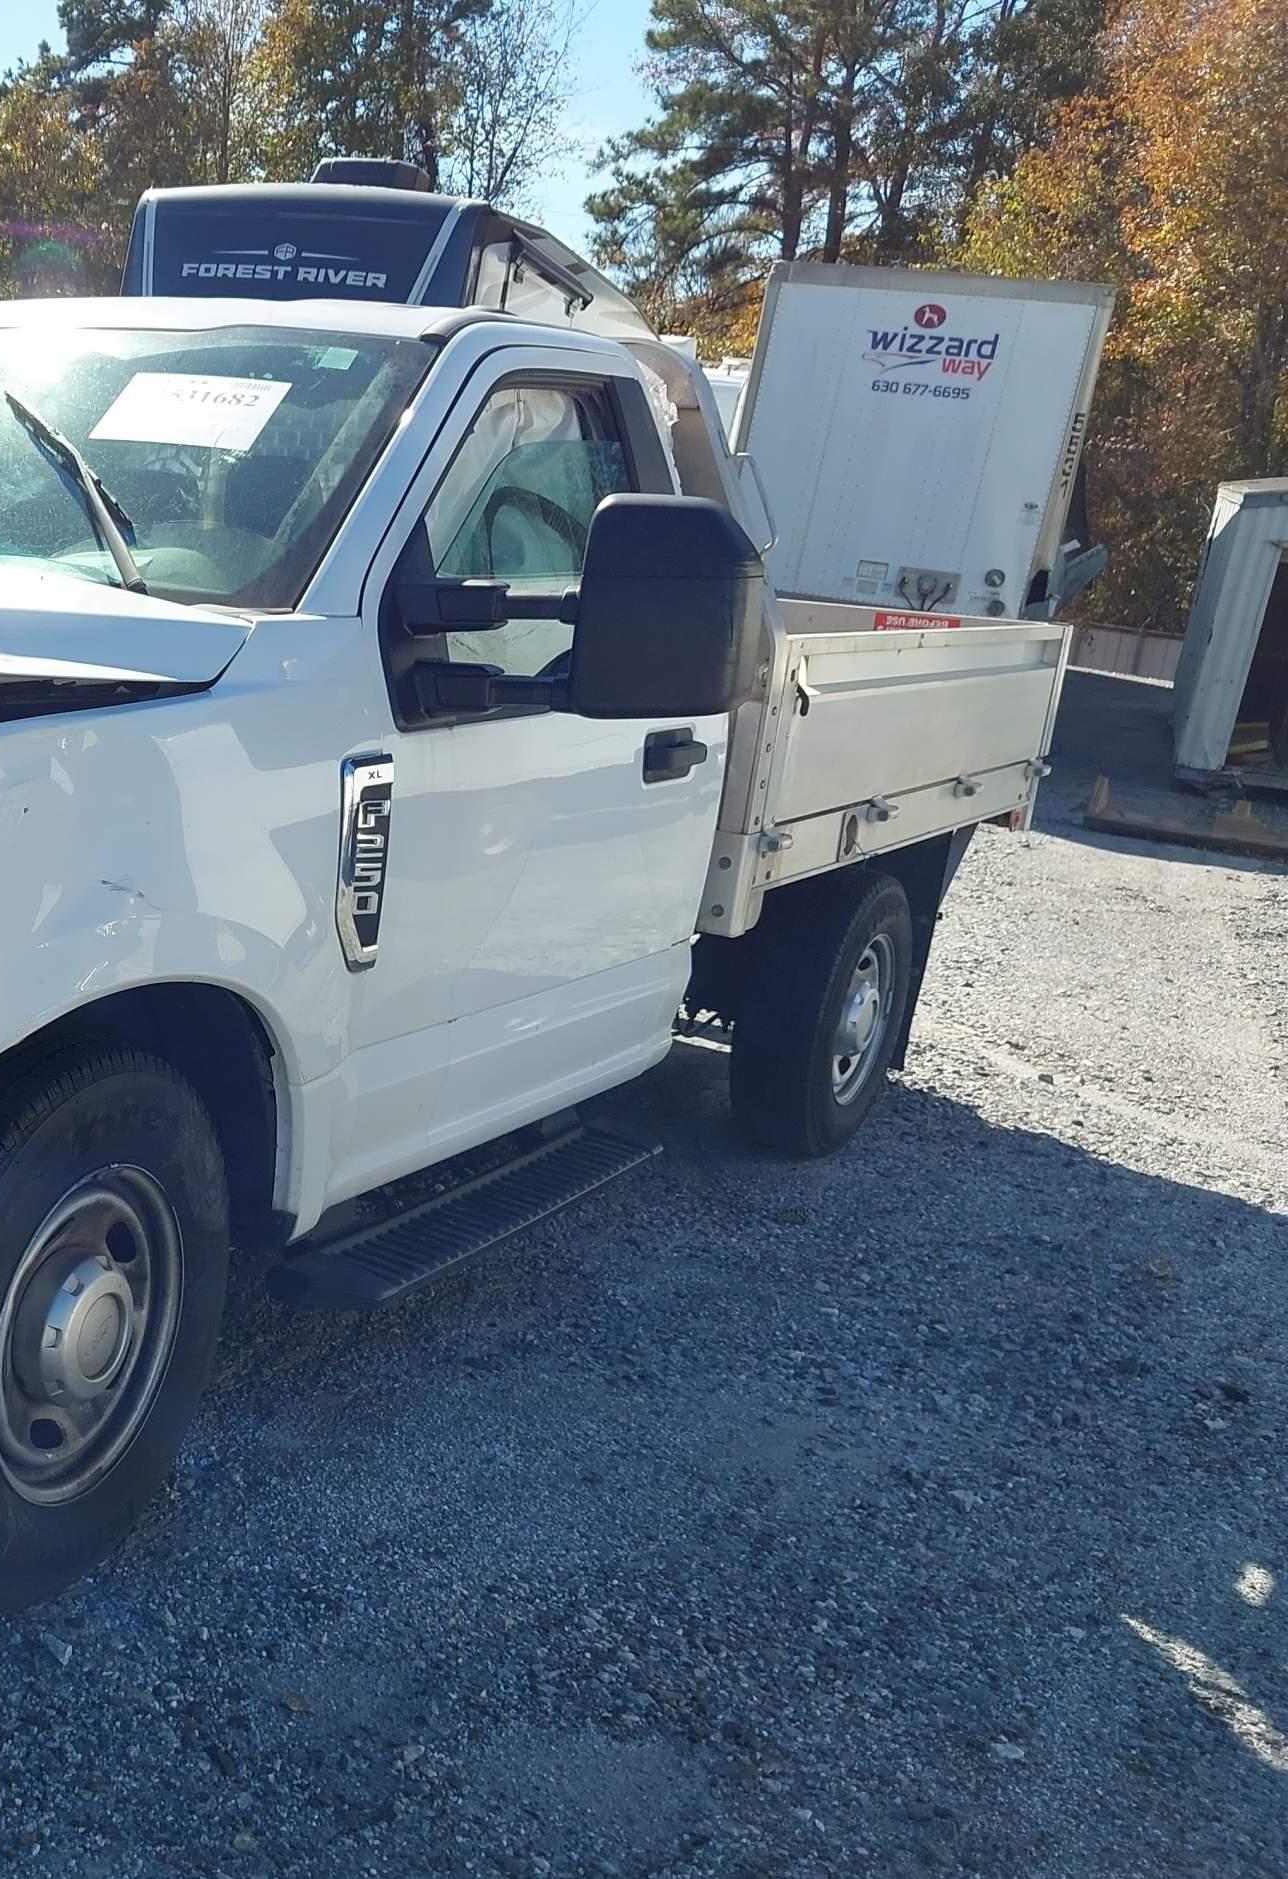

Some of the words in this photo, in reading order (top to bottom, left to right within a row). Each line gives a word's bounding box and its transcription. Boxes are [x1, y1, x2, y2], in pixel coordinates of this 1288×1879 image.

[182, 263, 292, 279] FOREST
[297, 267, 387, 288] RIVER
[867, 326, 1000, 360] wizzard
[942, 357, 992, 381] way
[872, 380, 899, 393] 630
[902, 383, 971, 400] 677-6695
[368, 771, 382, 779] XL
